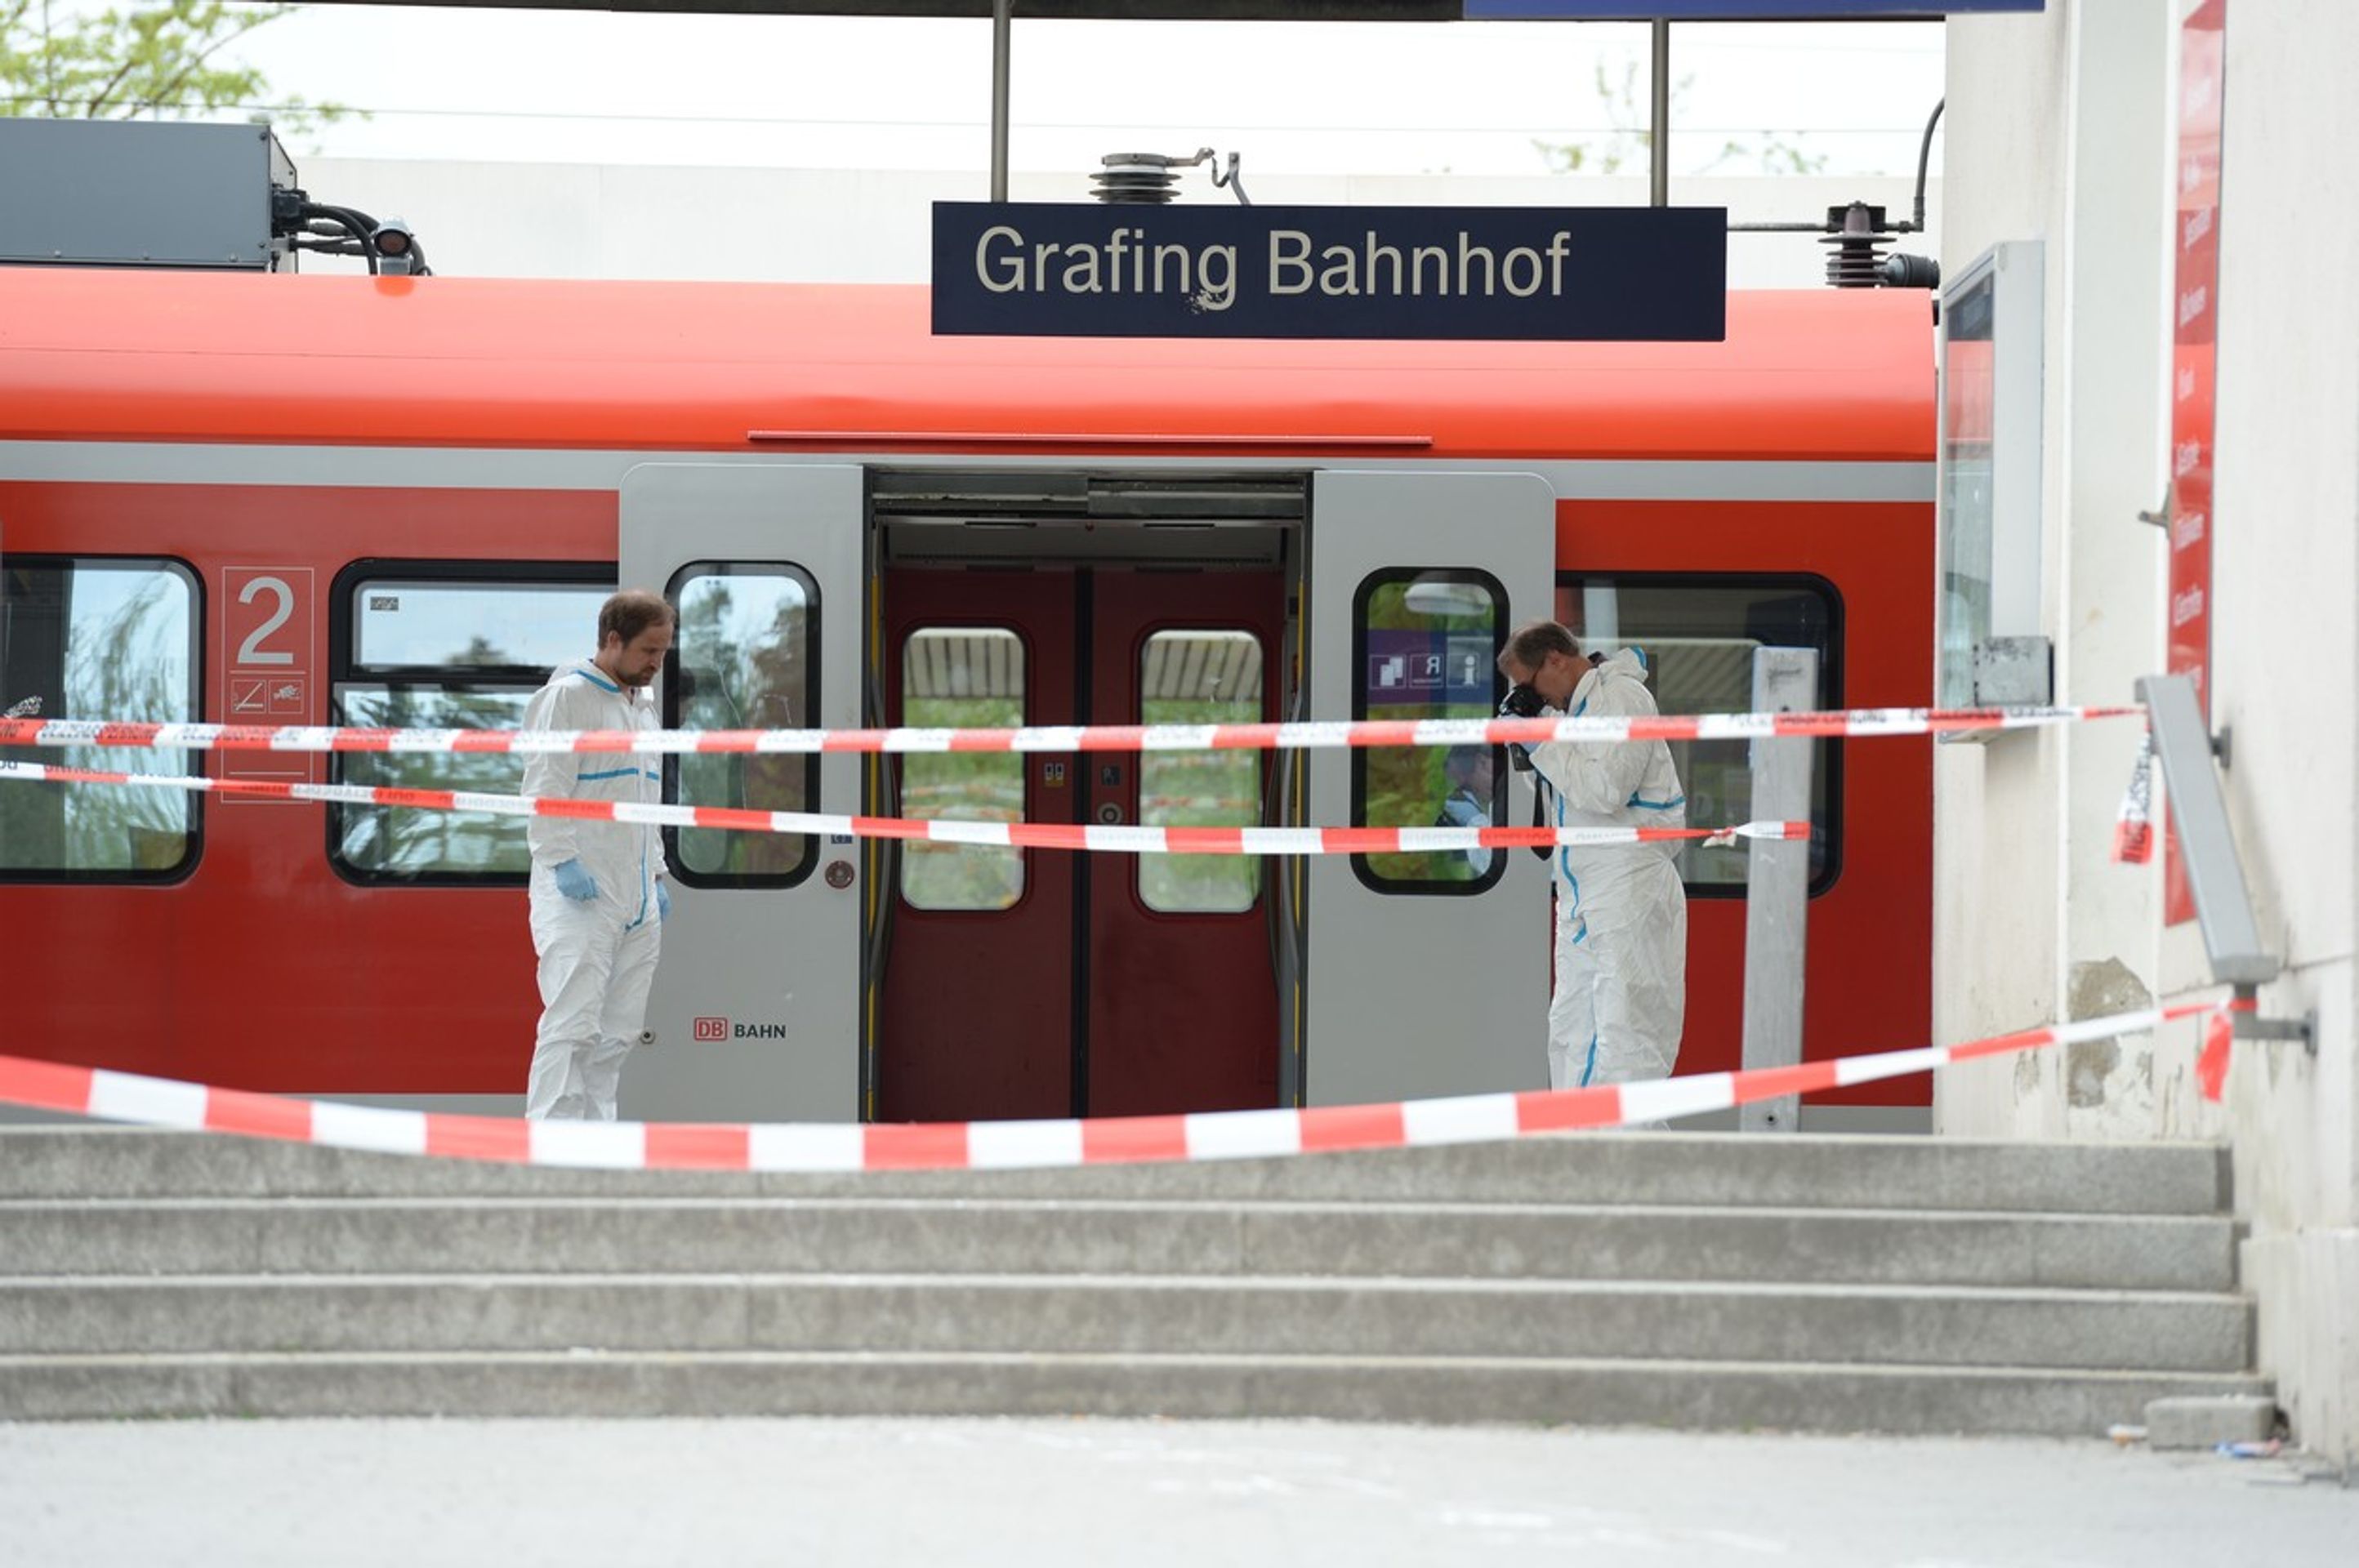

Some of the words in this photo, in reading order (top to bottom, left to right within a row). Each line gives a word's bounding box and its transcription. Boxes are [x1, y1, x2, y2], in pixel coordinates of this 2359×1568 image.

[976, 225, 1237, 310] Grafing
[1268, 229, 1571, 296] Bahnhof
[237, 577, 295, 665] 2
[698, 1020, 725, 1038] DB
[734, 1024, 787, 1039] BAHN
